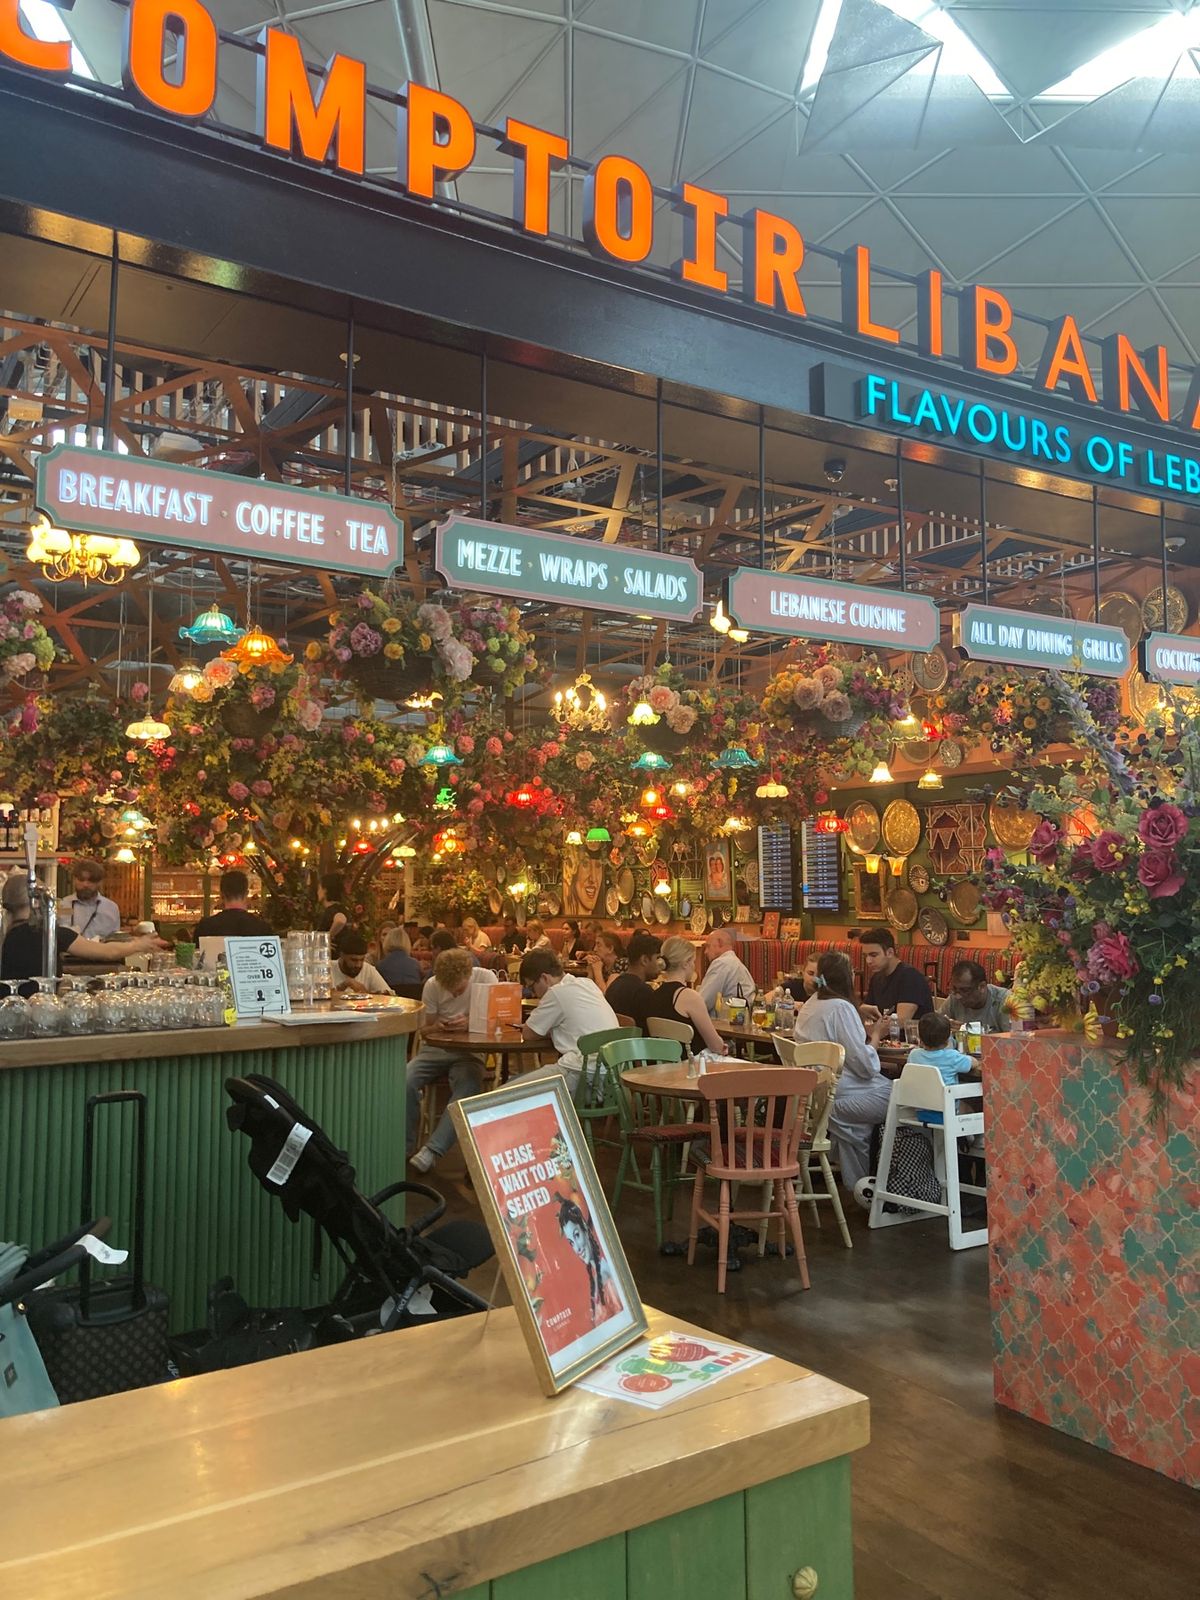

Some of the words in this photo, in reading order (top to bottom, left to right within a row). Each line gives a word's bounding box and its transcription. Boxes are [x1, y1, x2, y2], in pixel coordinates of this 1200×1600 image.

[857, 244, 1200, 430] LIBAN
[865, 373, 1072, 464] FLAVOURS
[1085, 434, 1135, 478] OF
[58, 468, 213, 526] BREAKFAST
[235, 500, 325, 545] COFFEE
[346, 519, 390, 556] TEA
[457, 538, 522, 577] MEZZE
[539, 552, 609, 590] WRAPS
[623, 567, 688, 602] SALADS
[770, 590, 846, 625] LEBANESE
[849, 602, 907, 633] CUISINE
[970, 620, 996, 645] ALL
[998, 624, 1025, 649] DAY
[1026, 629, 1073, 656] DINING
[1082, 639, 1124, 664] GRILLS
[260, 944, 275, 956] 25
[260, 968, 273, 979] 18
[489, 1143, 536, 1173] PLEASE
[499, 1168, 530, 1196] WAIT
[529, 1162, 547, 1184] TO
[544, 1155, 562, 1179] BE
[506, 1186, 551, 1219] SEATED
